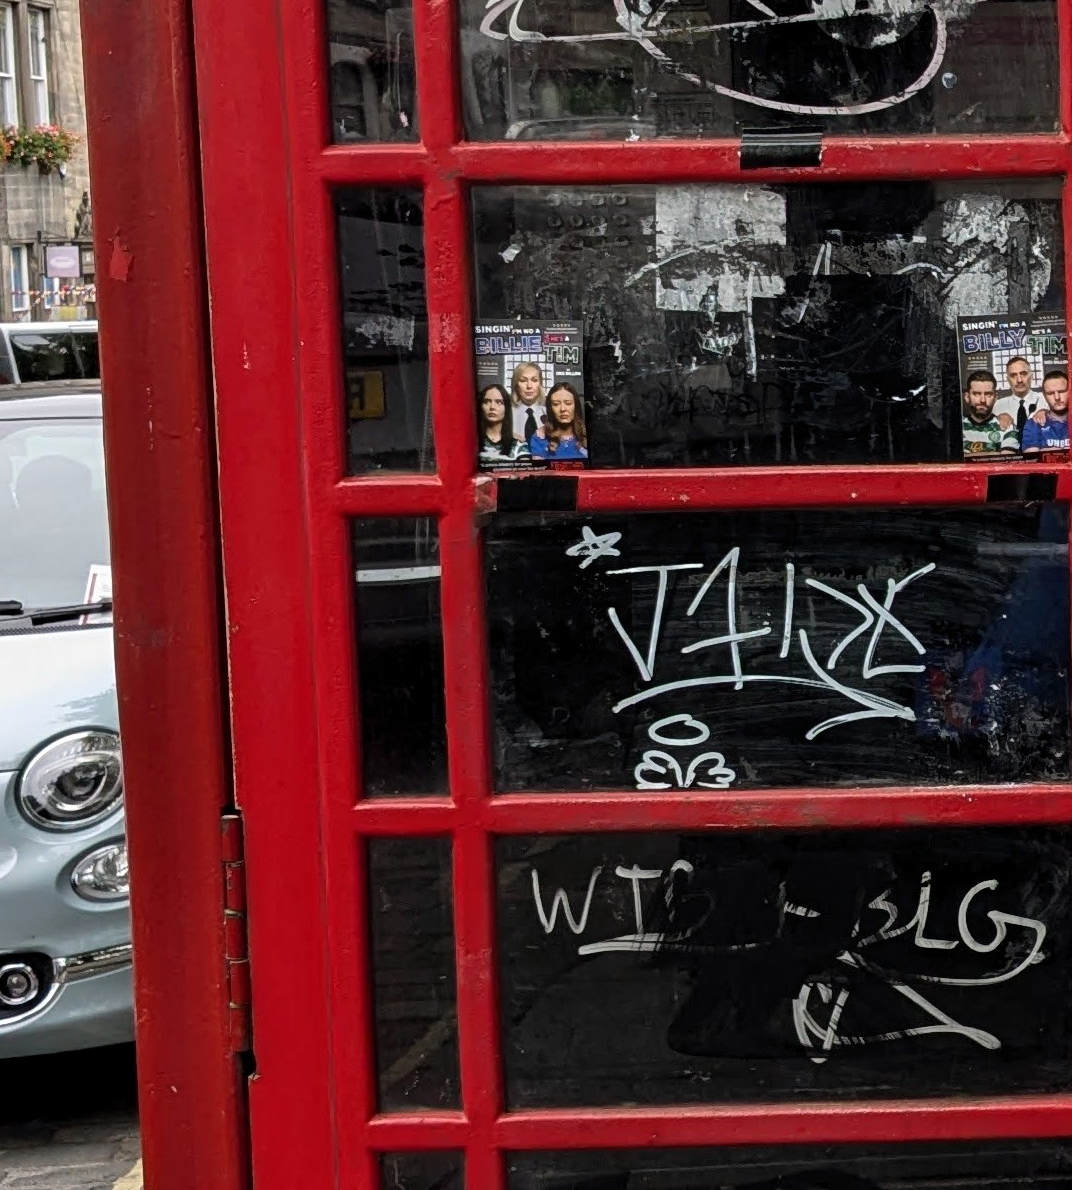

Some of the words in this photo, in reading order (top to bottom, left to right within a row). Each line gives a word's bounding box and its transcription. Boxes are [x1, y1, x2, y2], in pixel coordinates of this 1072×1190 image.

[474, 324, 513, 334] SINGIN'
[962, 321, 997, 331] SINGIN'
[474, 335, 542, 355] BILLIE
[962, 329, 1026, 354] BILLY
[1027, 335, 1069, 356] TIM
[543, 343, 580, 364] TIM
